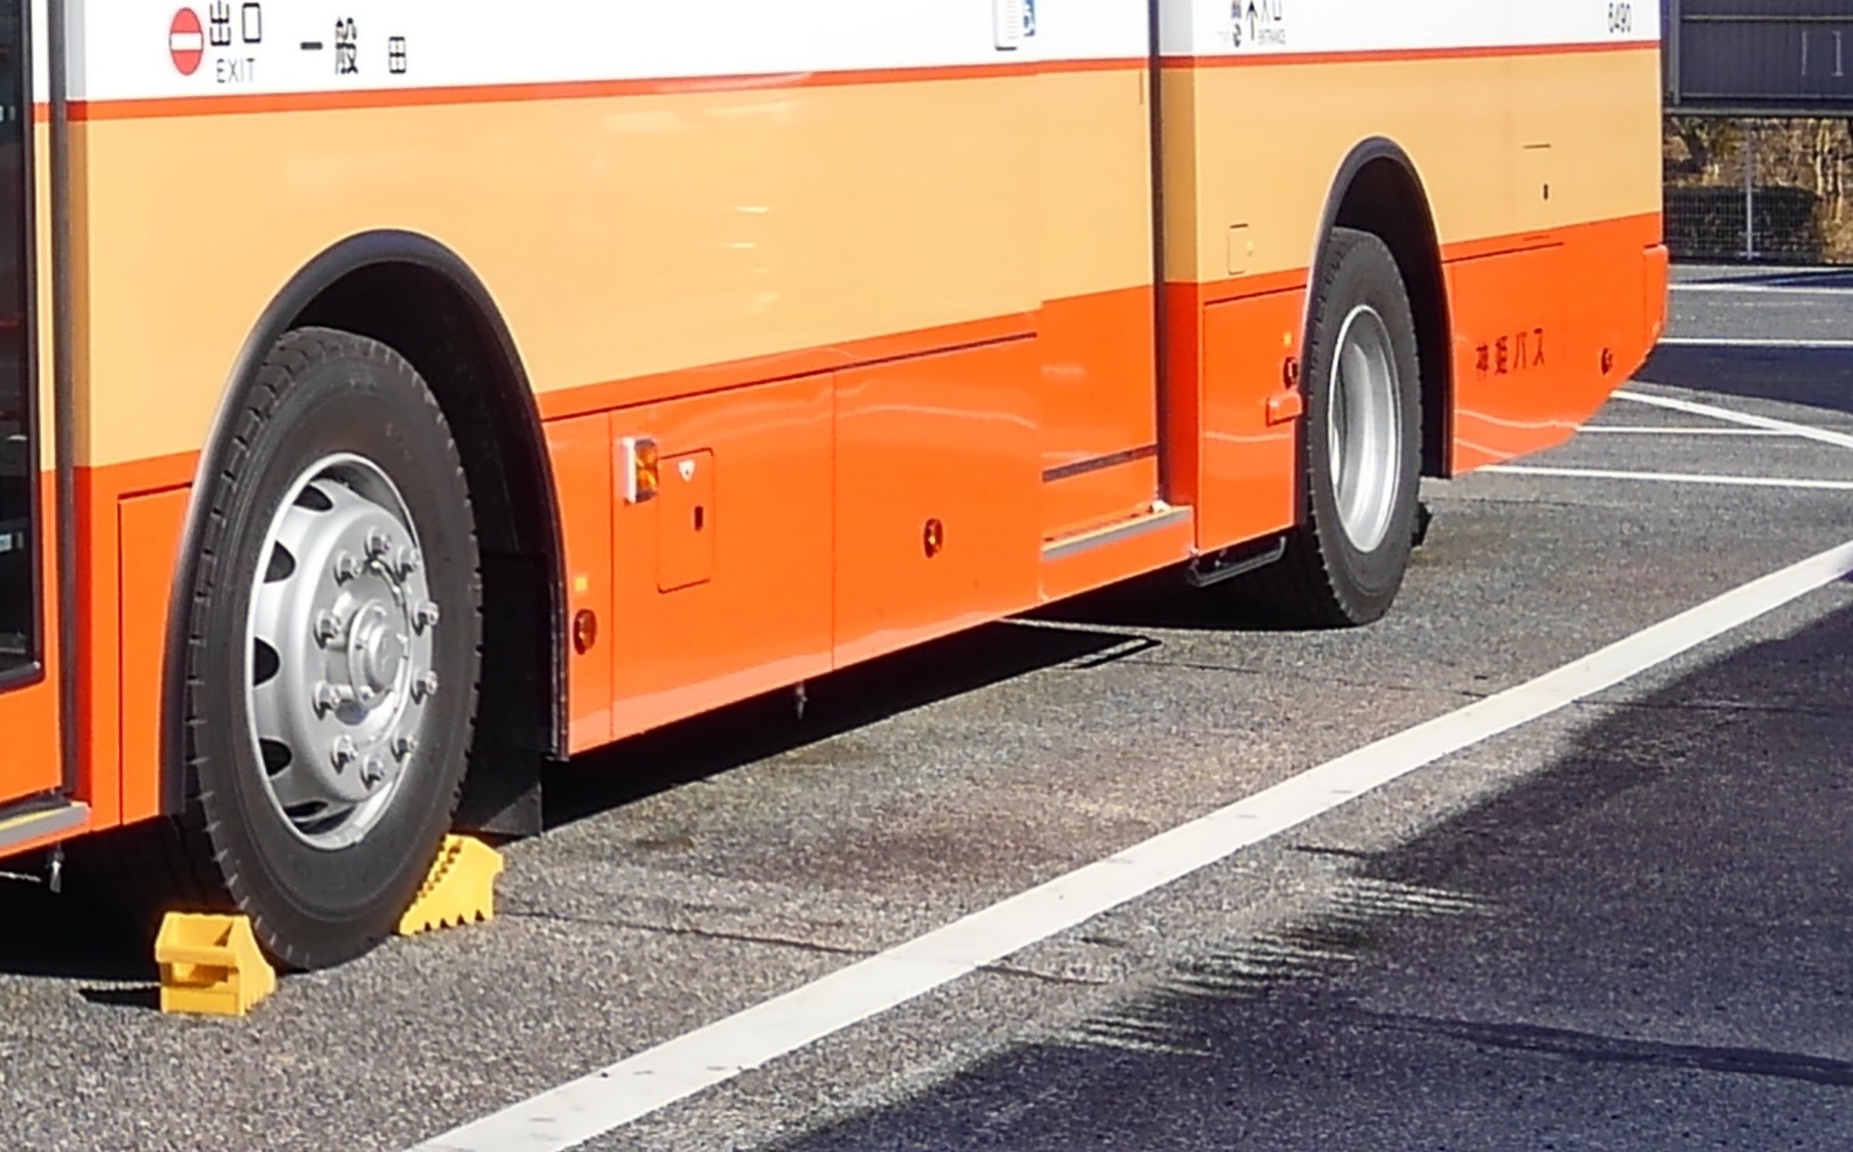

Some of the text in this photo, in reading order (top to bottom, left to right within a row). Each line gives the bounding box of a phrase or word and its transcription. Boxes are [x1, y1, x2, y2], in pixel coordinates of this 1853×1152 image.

[209, 0, 263, 47] 出口
[299, 14, 359, 76] 一般
[215, 58, 256, 84] EXIT
